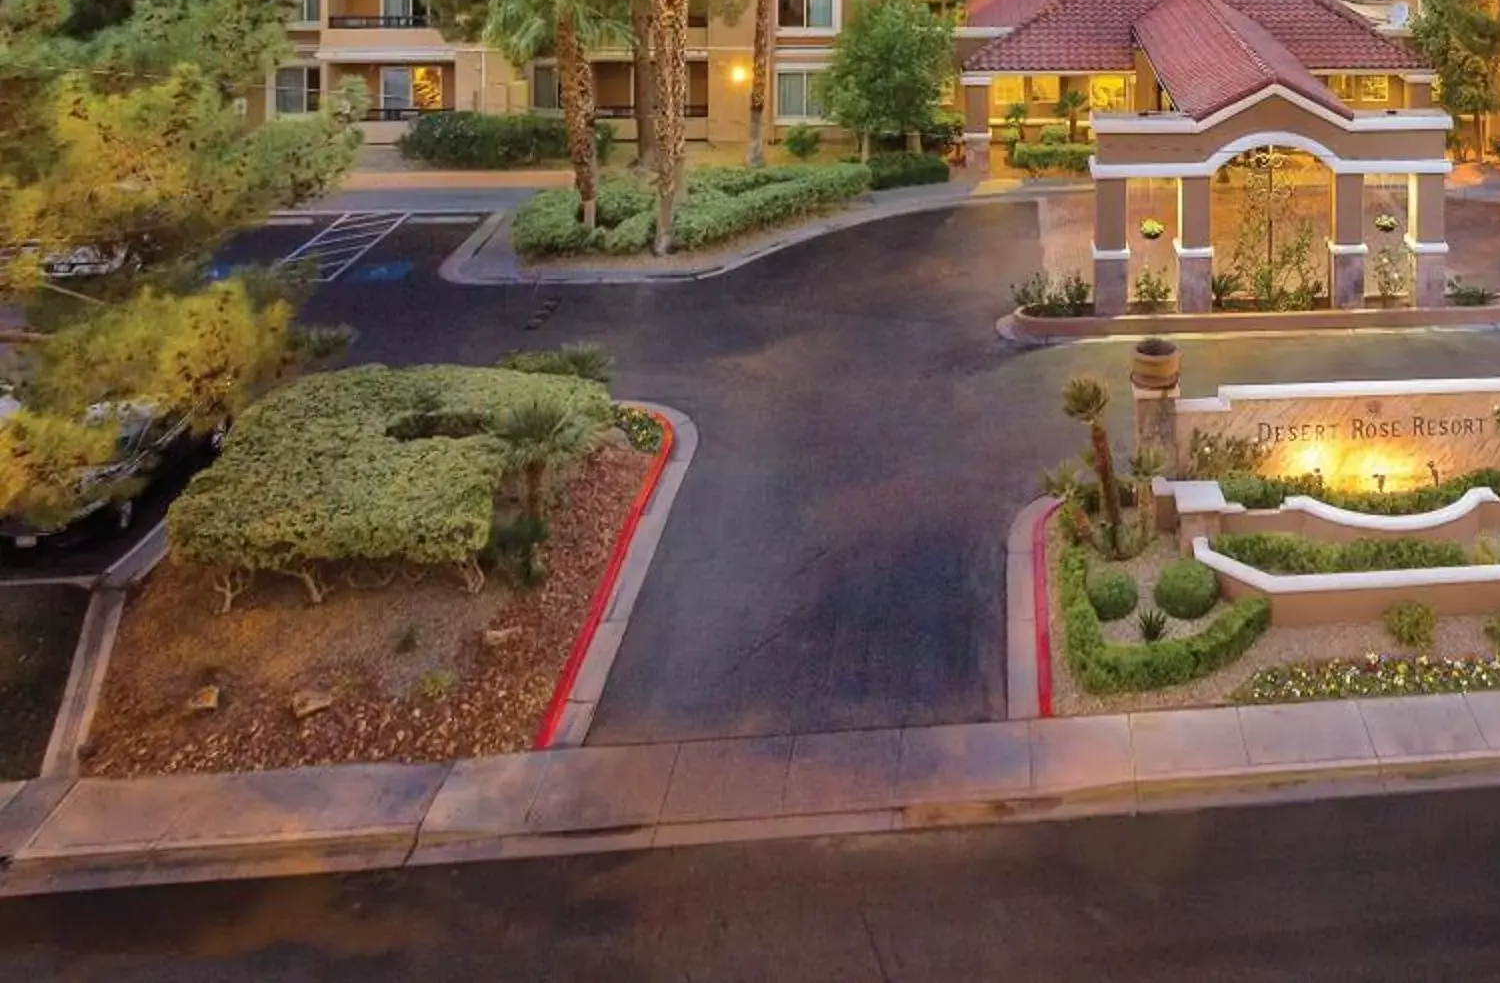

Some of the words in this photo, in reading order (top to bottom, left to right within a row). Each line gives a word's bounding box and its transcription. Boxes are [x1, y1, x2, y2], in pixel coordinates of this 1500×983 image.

[1256, 421, 1338, 443] DESERT
[1351, 417, 1402, 439] ROSE
[1411, 415, 1485, 436] RESORT
